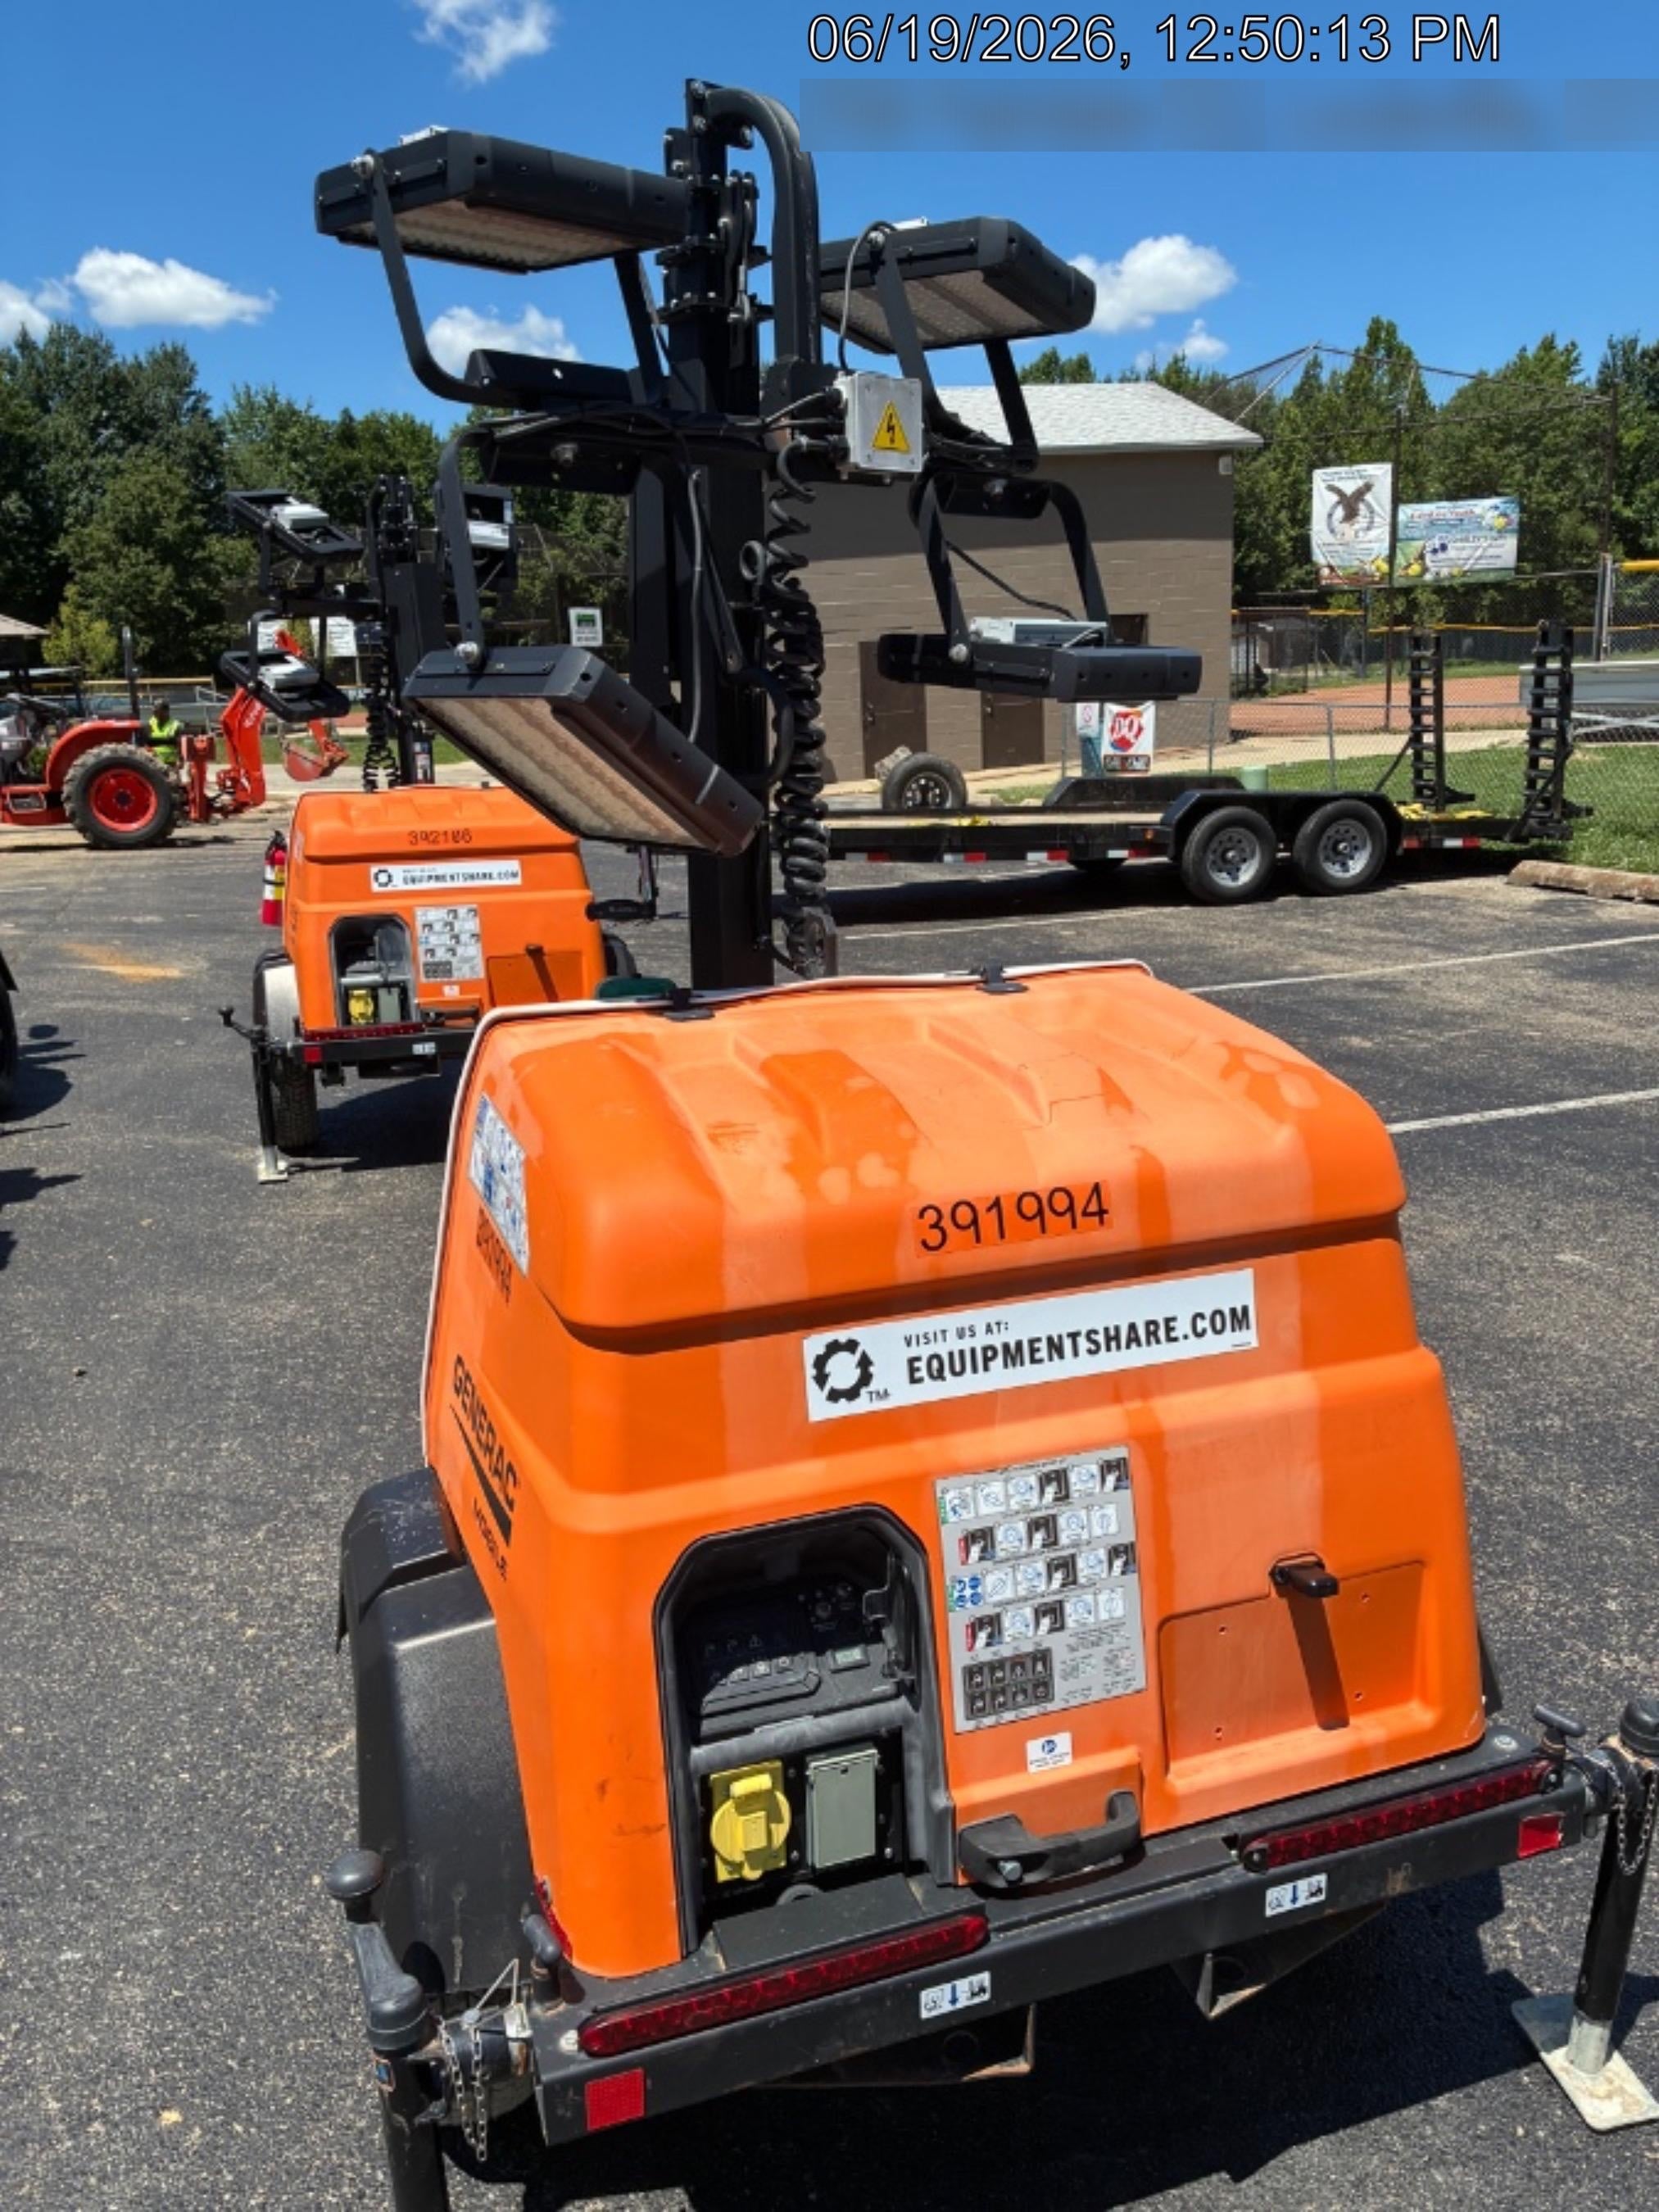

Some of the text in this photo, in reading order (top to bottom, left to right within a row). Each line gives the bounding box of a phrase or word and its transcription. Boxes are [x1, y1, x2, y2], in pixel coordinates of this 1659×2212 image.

[917, 1181, 1109, 1252] 391994
[904, 1321, 1009, 1348] VISIT US AT:
[907, 1304, 1252, 1385] EQUIPMENTSHARE.COM
[454, 1353, 518, 1512] GENERAC
